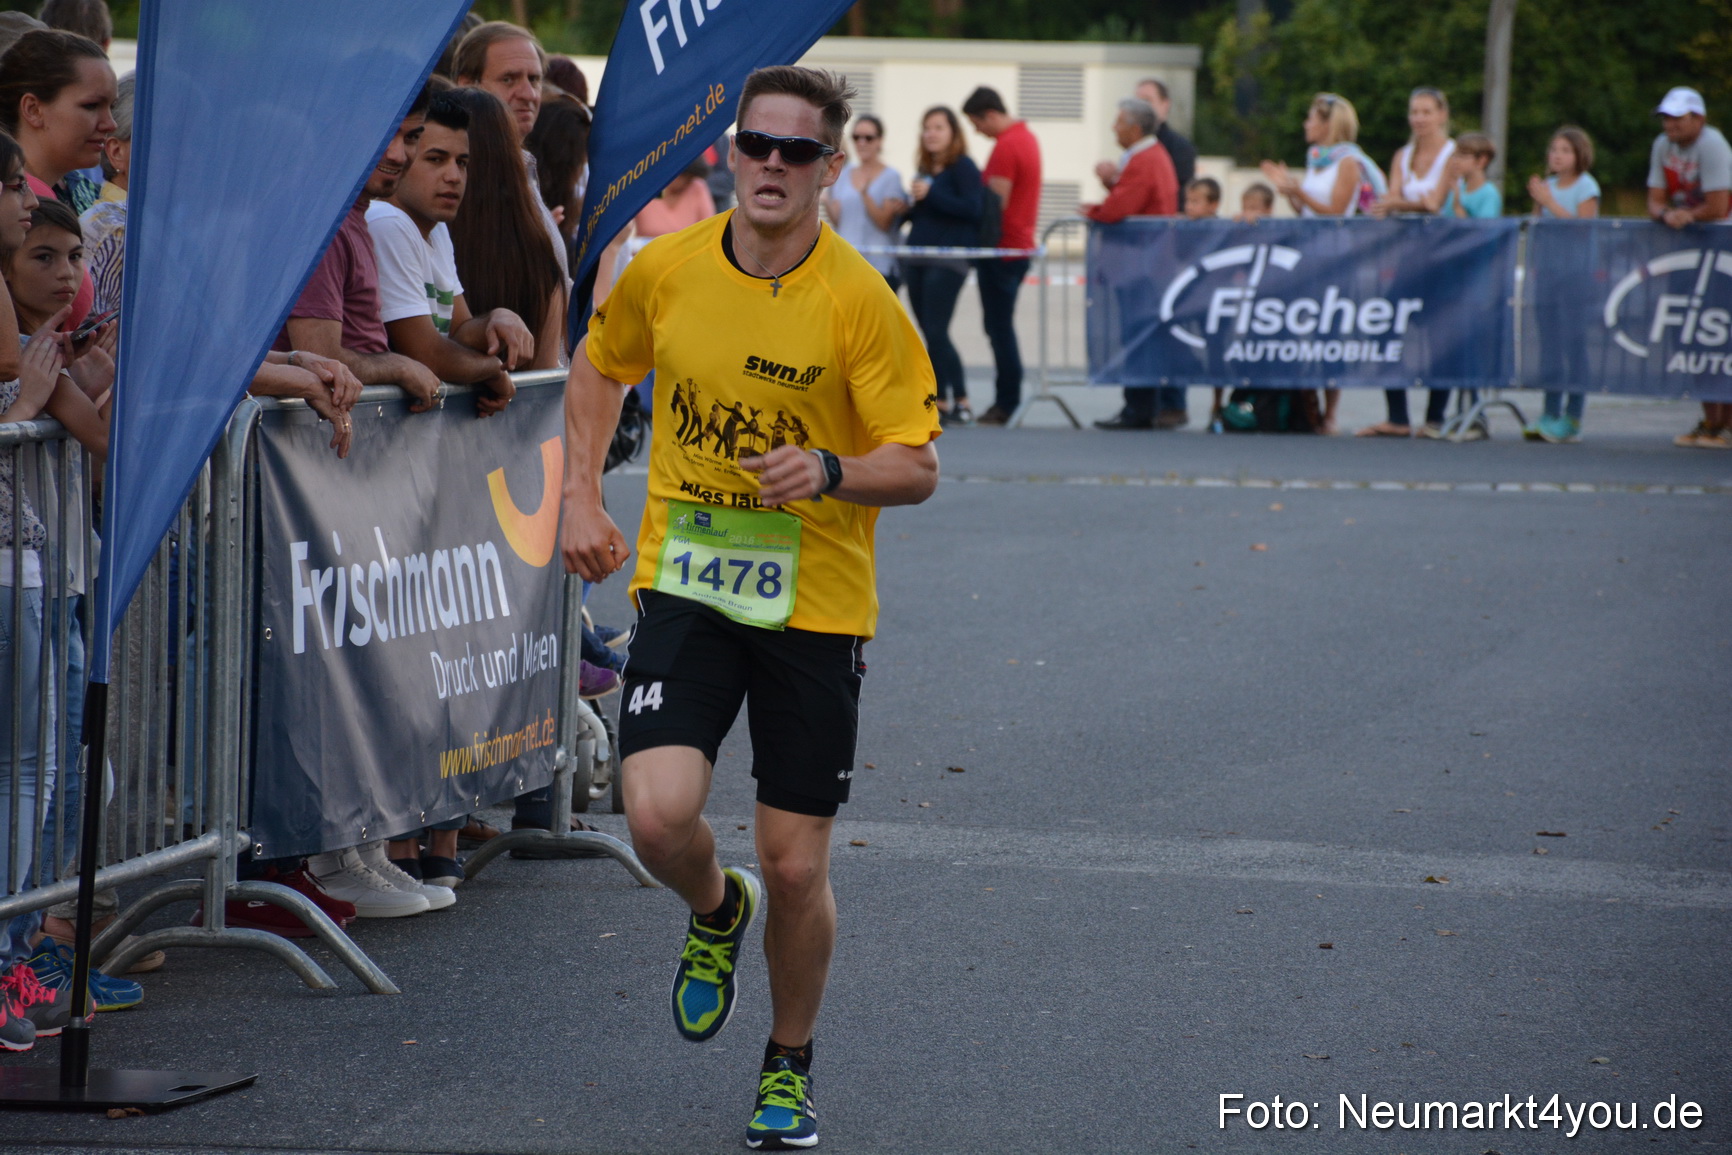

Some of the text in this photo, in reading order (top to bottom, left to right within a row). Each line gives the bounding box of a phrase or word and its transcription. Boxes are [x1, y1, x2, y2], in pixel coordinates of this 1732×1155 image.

[1205, 285, 1424, 335] Fischer
[1224, 340, 1404, 363] AUTOMOBILE
[742, 370, 809, 393] stadtwerke neumarkt
[744, 355, 798, 383] swn
[686, 521, 728, 538] firmenlauf
[290, 526, 511, 655] Frischmann
[673, 551, 782, 599] 1478
[727, 600, 753, 611] Braun
[430, 641, 480, 700] Druck
[481, 632, 518, 689] und
[628, 681, 664, 716] 44
